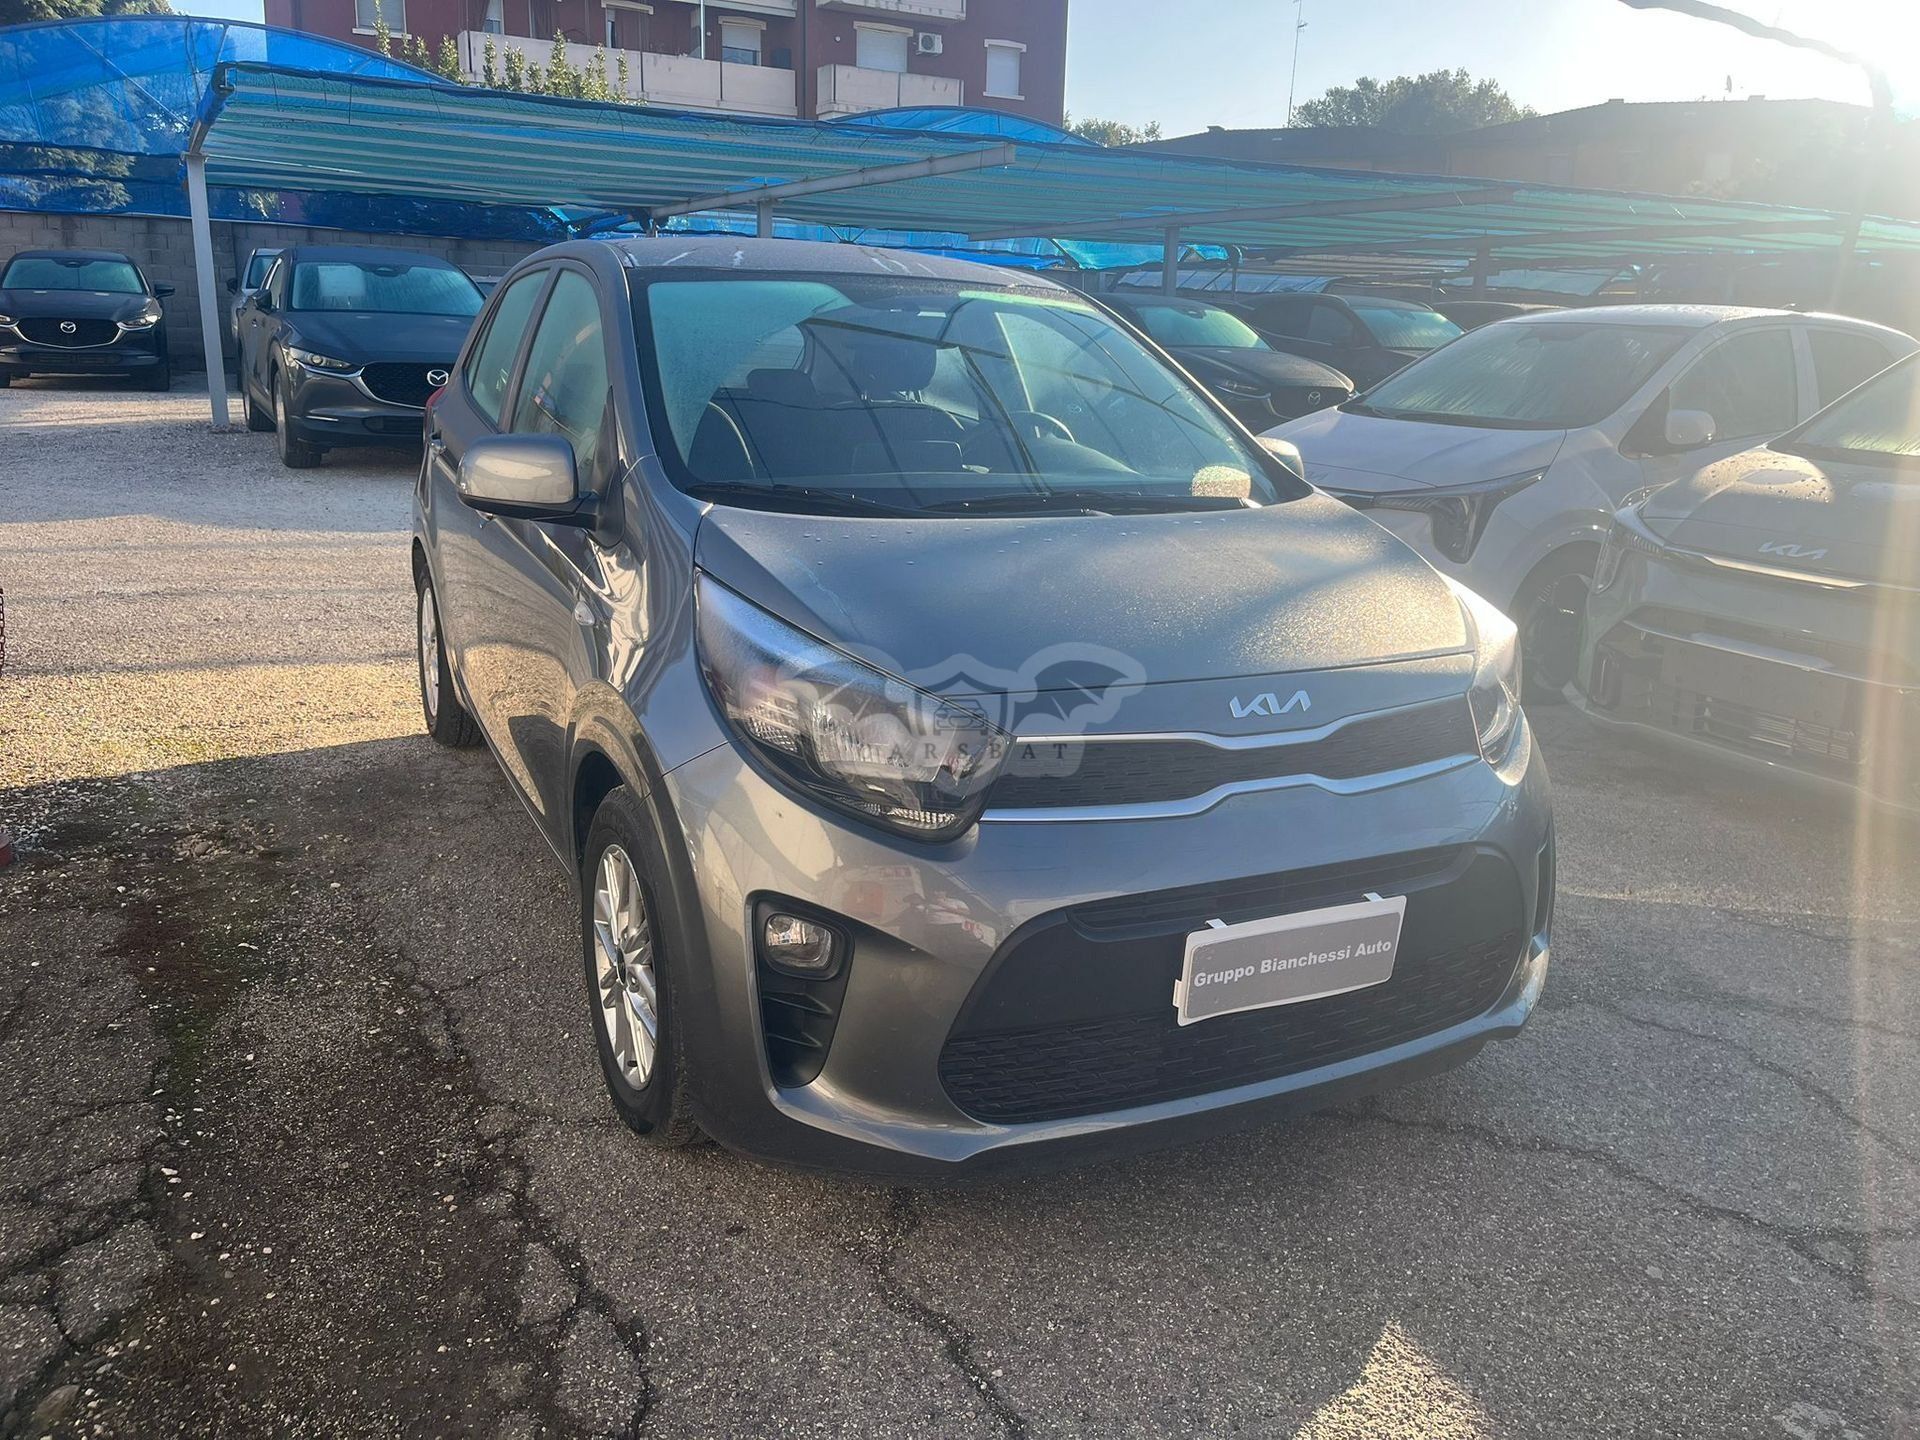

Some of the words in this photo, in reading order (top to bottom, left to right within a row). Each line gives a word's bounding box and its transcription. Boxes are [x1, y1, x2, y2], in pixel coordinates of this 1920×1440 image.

[1229, 690, 1312, 718] KIA
[1194, 964, 1255, 987] Gruppo
[1260, 945, 1351, 974] Bianchessi
[1354, 941, 1392, 957] Auto
